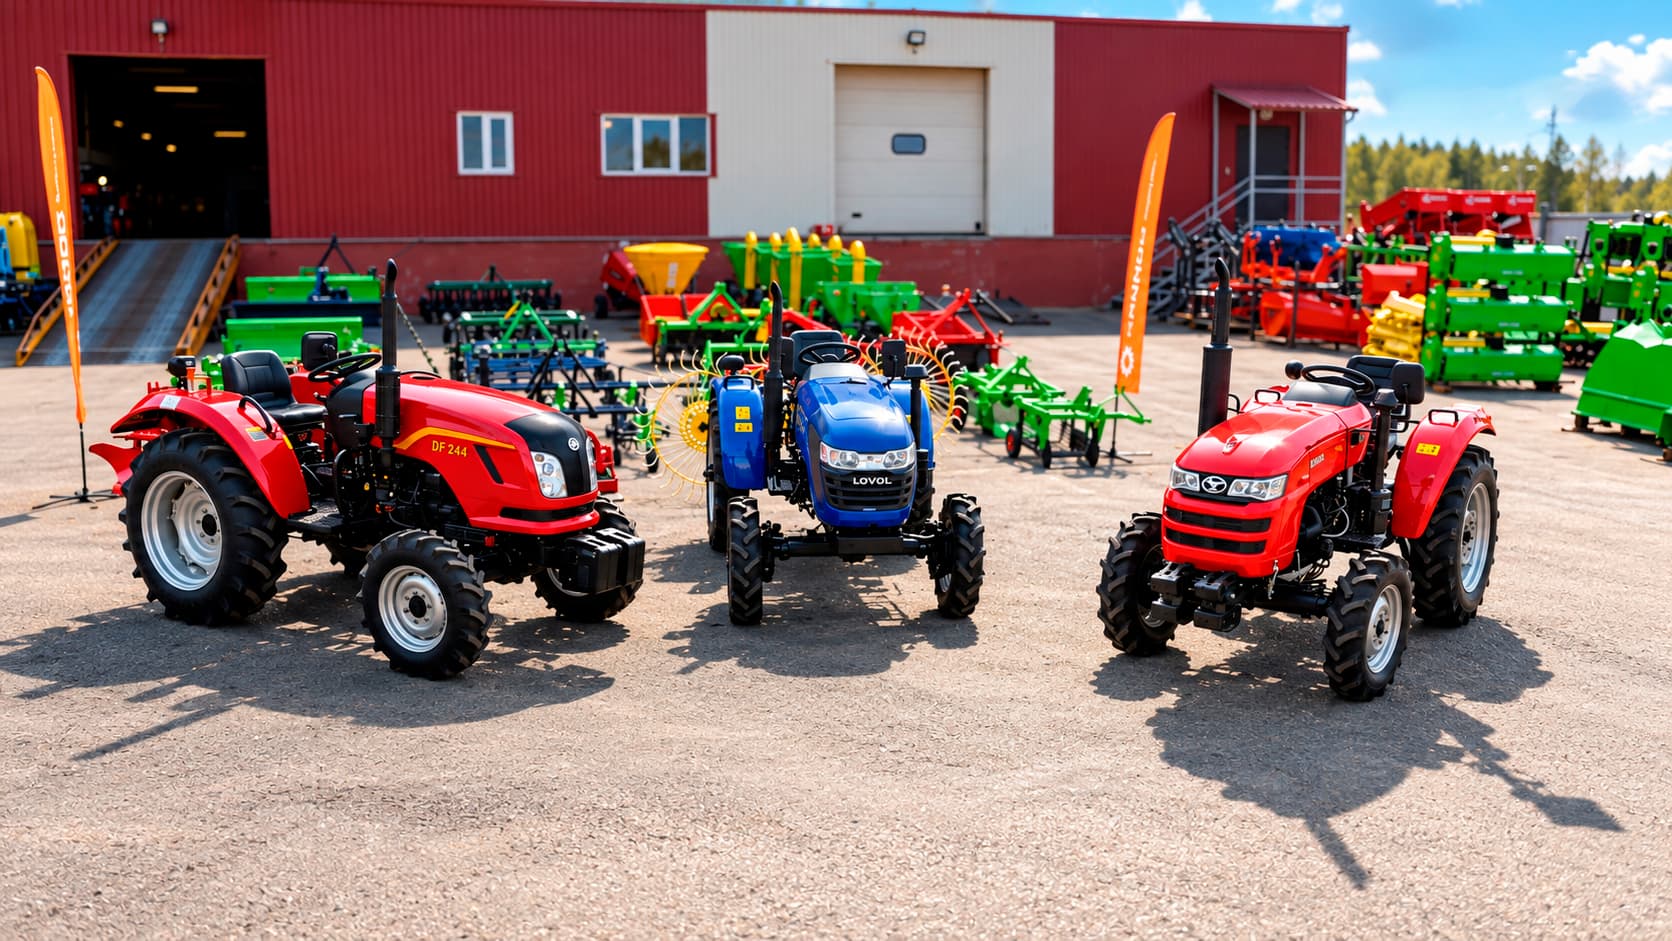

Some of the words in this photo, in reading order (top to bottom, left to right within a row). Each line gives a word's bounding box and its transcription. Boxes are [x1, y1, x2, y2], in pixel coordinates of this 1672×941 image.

[432, 440, 446, 452] DF
[448, 444, 467, 457] 244
[853, 476, 892, 485] LOVOL
